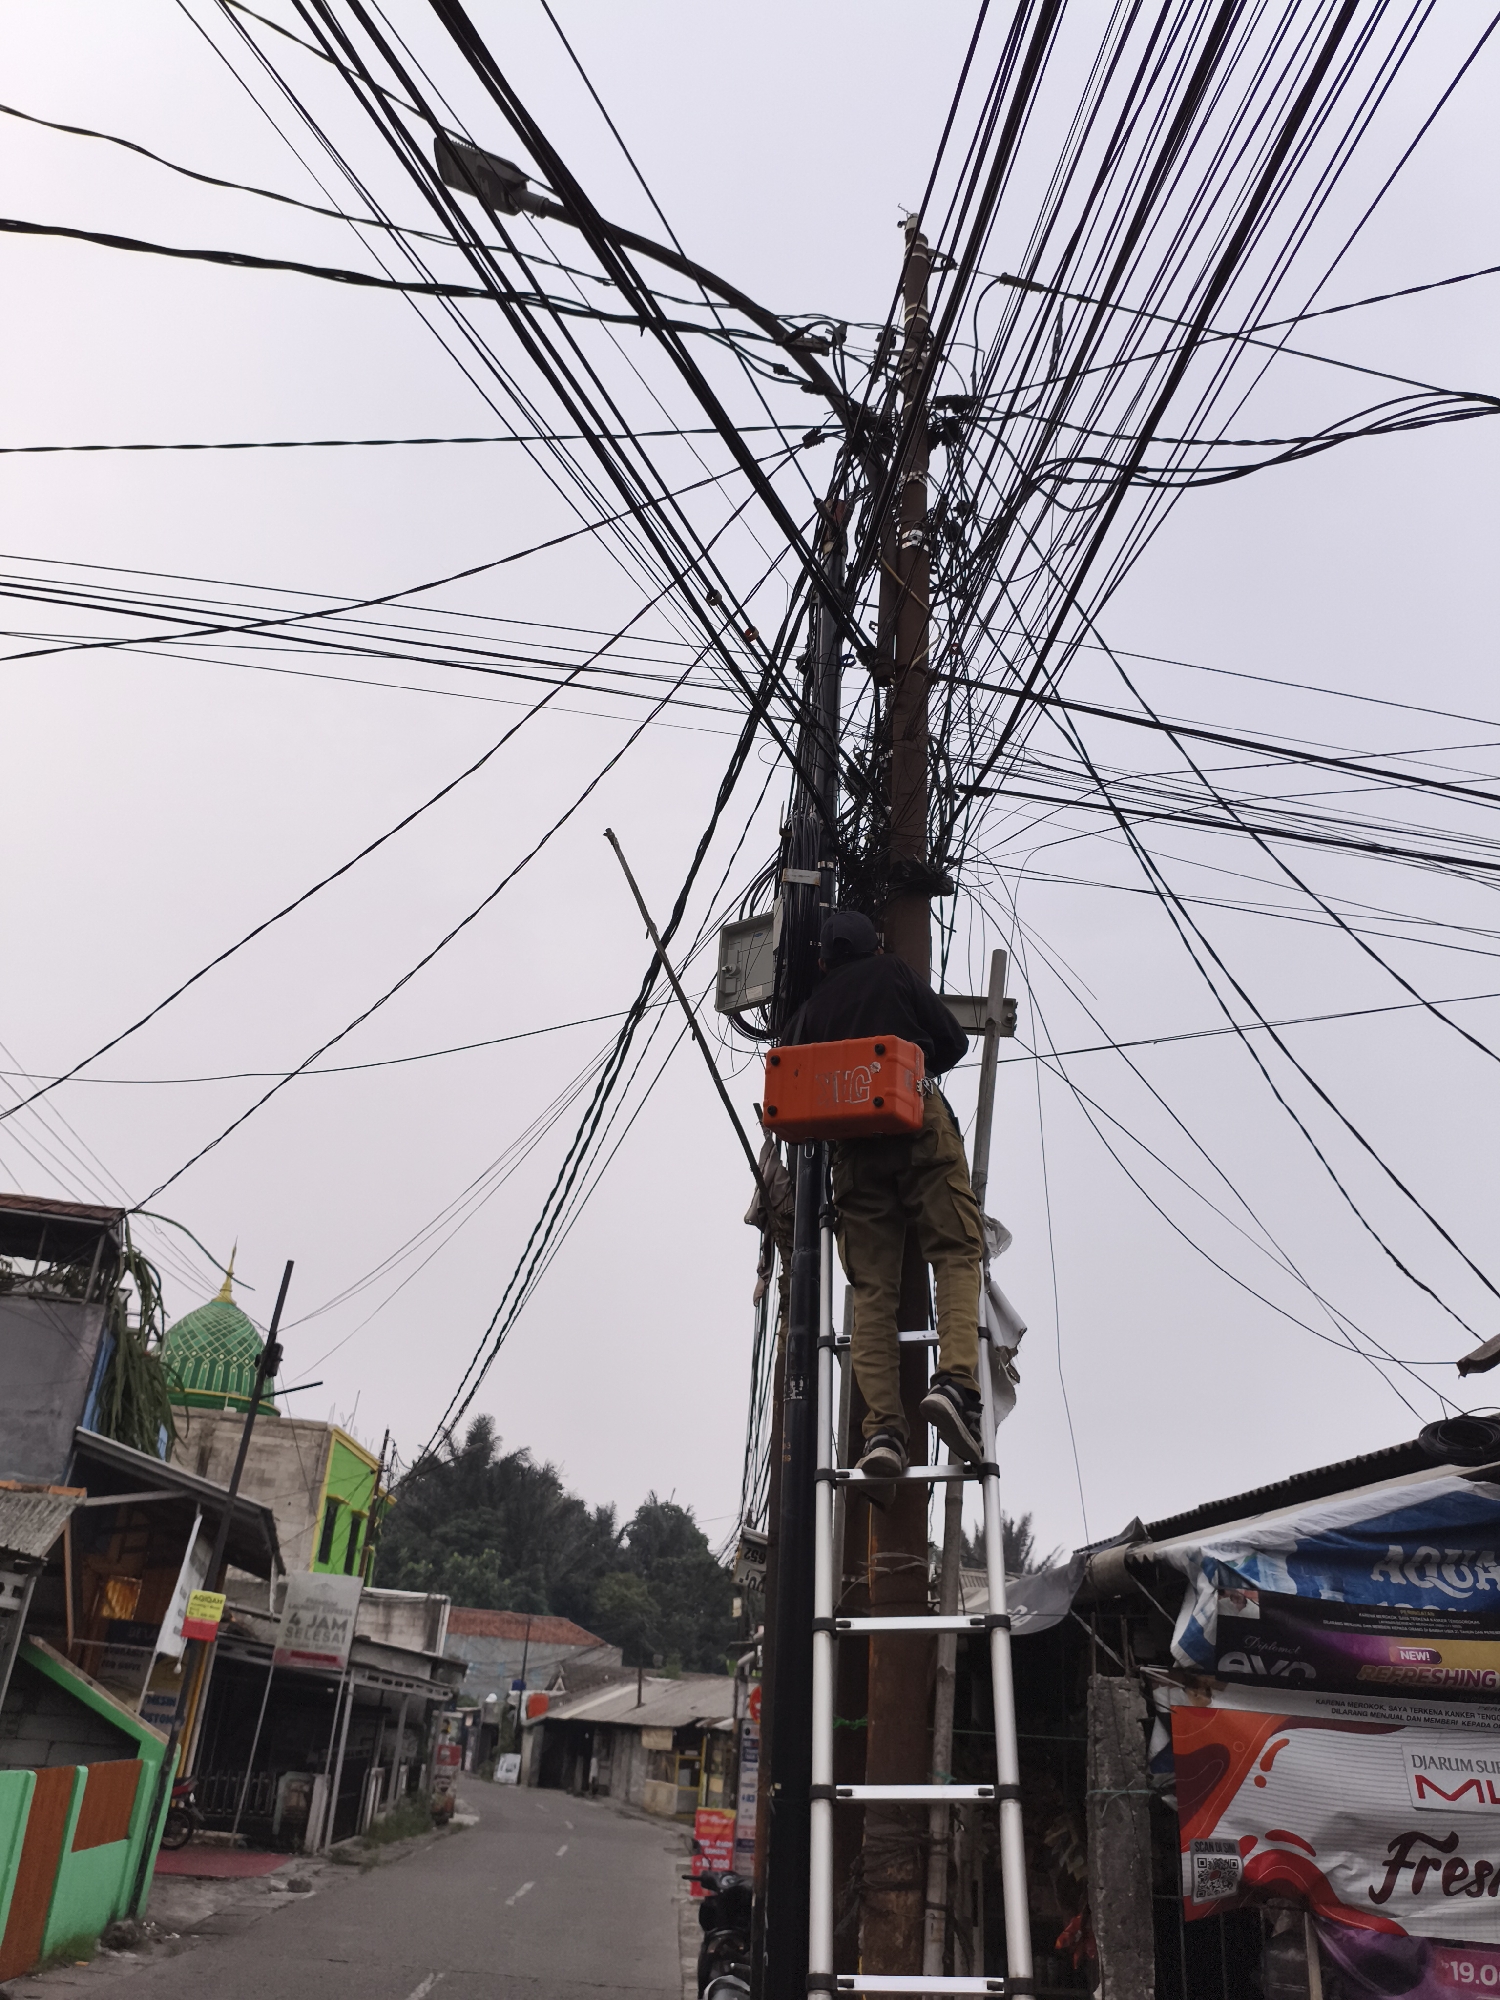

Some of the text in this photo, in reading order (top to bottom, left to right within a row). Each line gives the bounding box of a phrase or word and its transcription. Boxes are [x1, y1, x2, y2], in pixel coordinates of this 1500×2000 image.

[1370, 1545, 1500, 1598] AQUA
[307, 1614, 349, 1632] JAM
[285, 1626, 347, 1644] SELESAI
[1400, 1650, 1430, 1661] NEW!
[1356, 1664, 1499, 1689] REFRESHING
[1315, 1699, 1345, 1708] KARENA
[1388, 1704, 1407, 1713] SAYA
[1409, 1706, 1443, 1716] TERKENA
[1445, 1710, 1475, 1719] KANKER
[1331, 1708, 1368, 1718] DILARANG
[1370, 1712, 1404, 1721] MENJUAL
[1406, 1715, 1422, 1723] DAN
[1423, 1717, 1458, 1726] MEMBERI
[1461, 1720, 1491, 1729] KEPADA
[1411, 1754, 1474, 1773] DJARUM
[1194, 1841, 1215, 1852] SCAN
[1215, 1841, 1223, 1853] DI
[1450, 1961, 1500, 1986] 19.0
